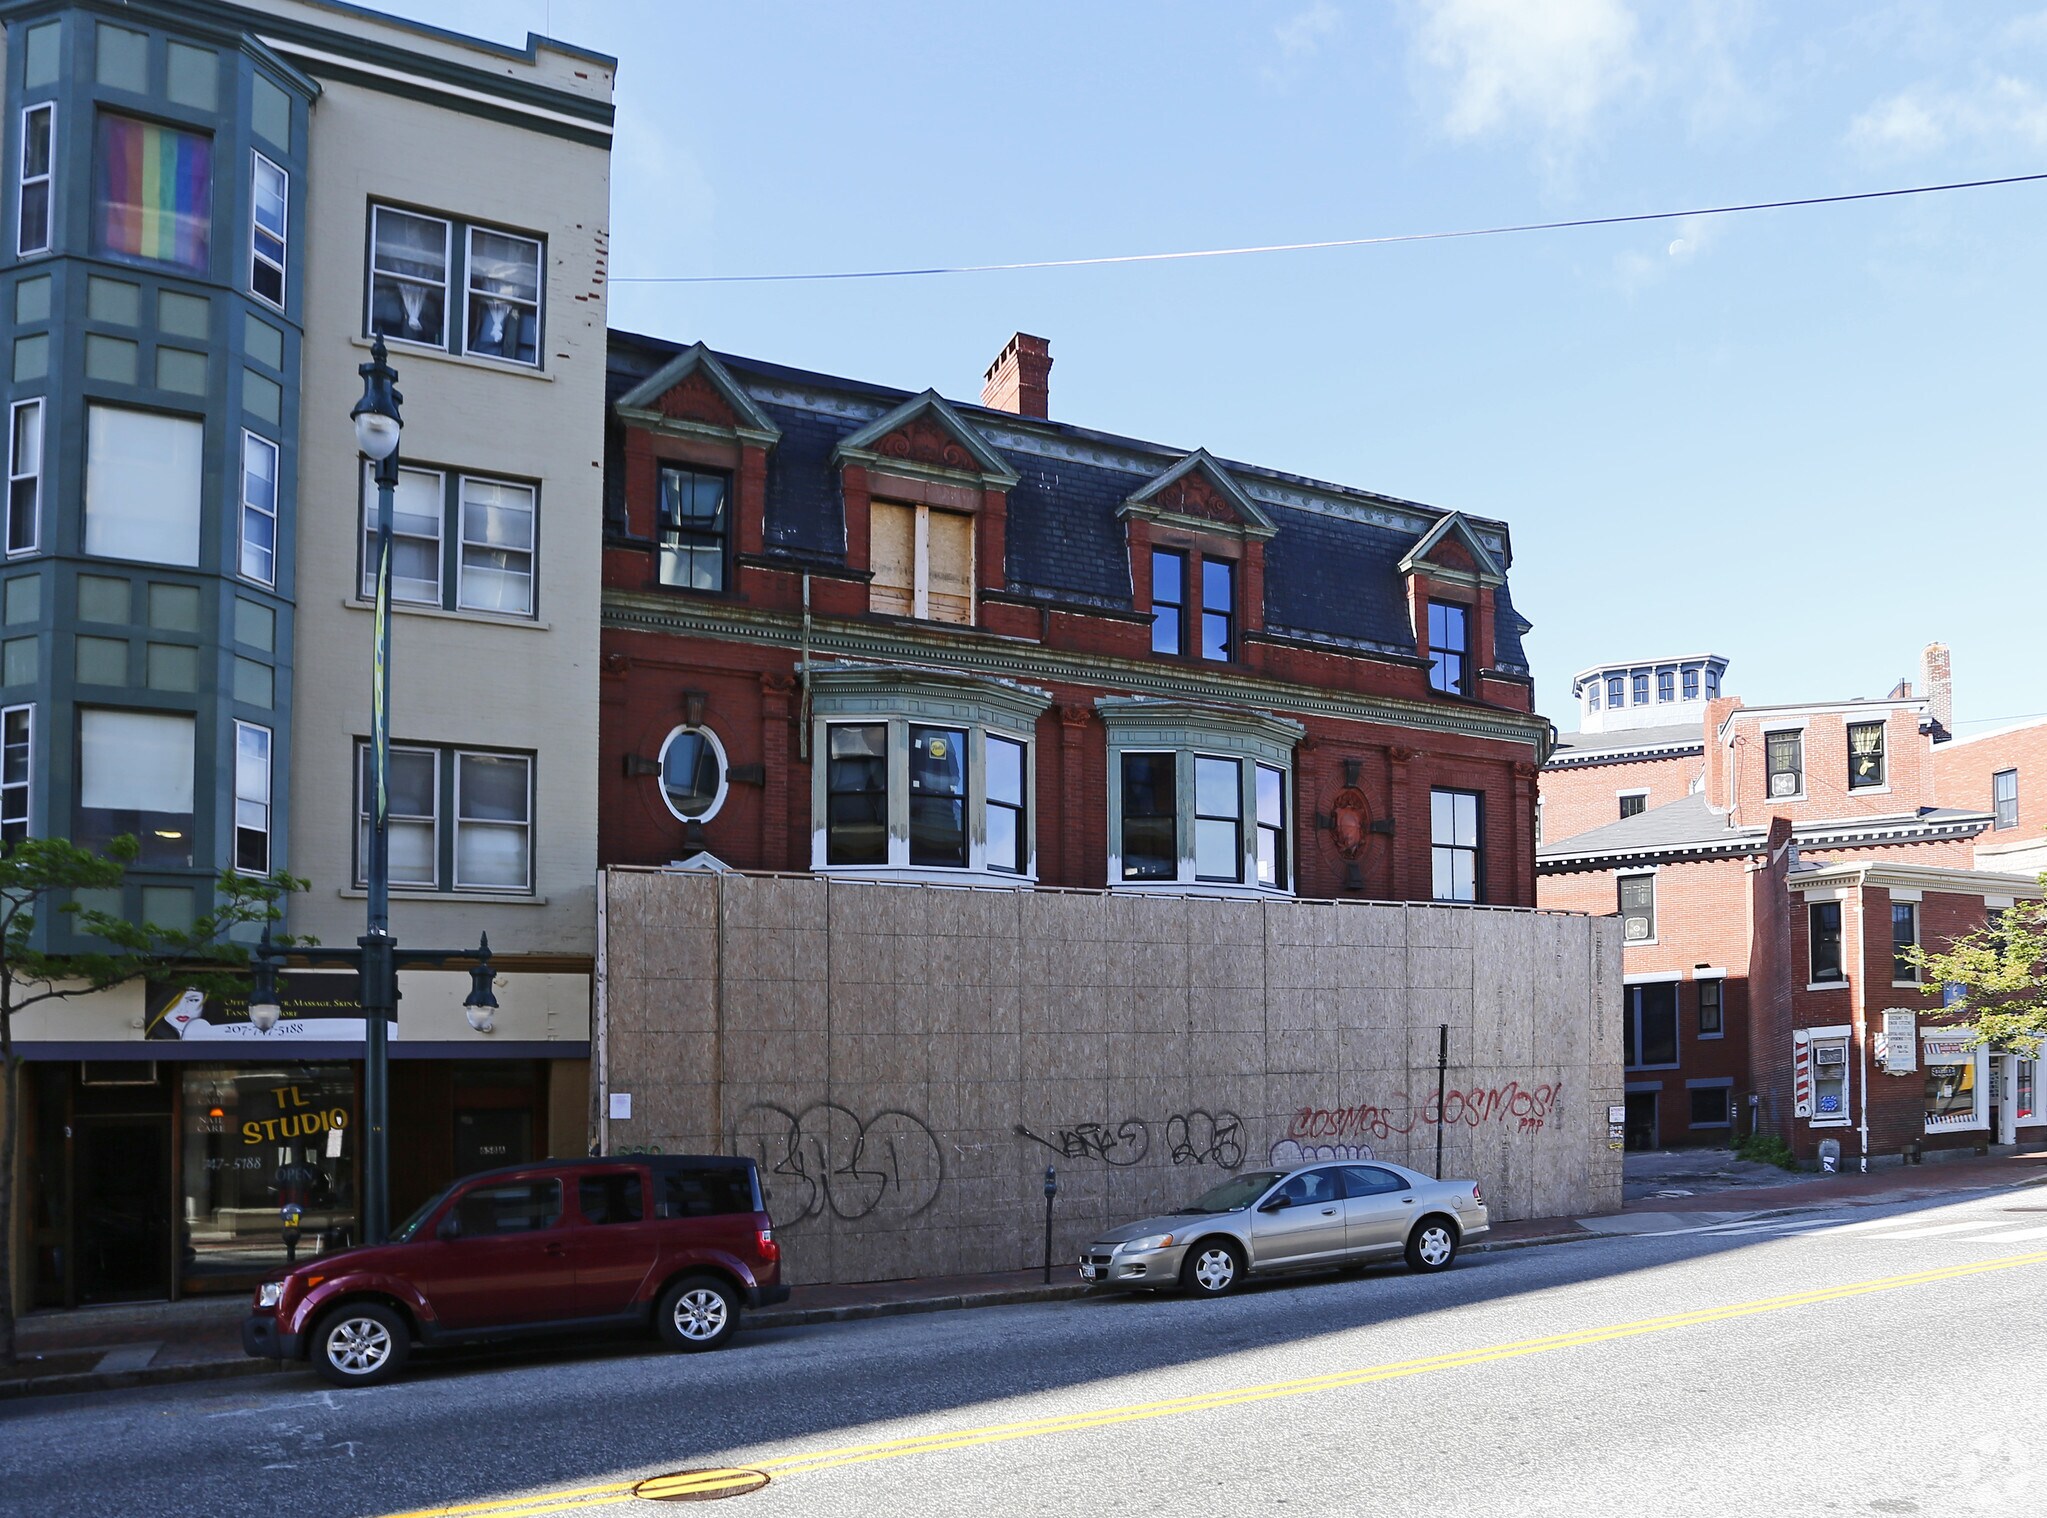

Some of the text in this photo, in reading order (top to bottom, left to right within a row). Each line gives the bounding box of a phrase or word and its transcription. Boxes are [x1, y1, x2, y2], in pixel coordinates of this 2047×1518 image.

[224, 1023, 304, 1036] 207-77-5188
[270, 1086, 310, 1109] TL
[242, 1107, 349, 1144] STUDIO
[275, 1167, 314, 1181] OPEN
